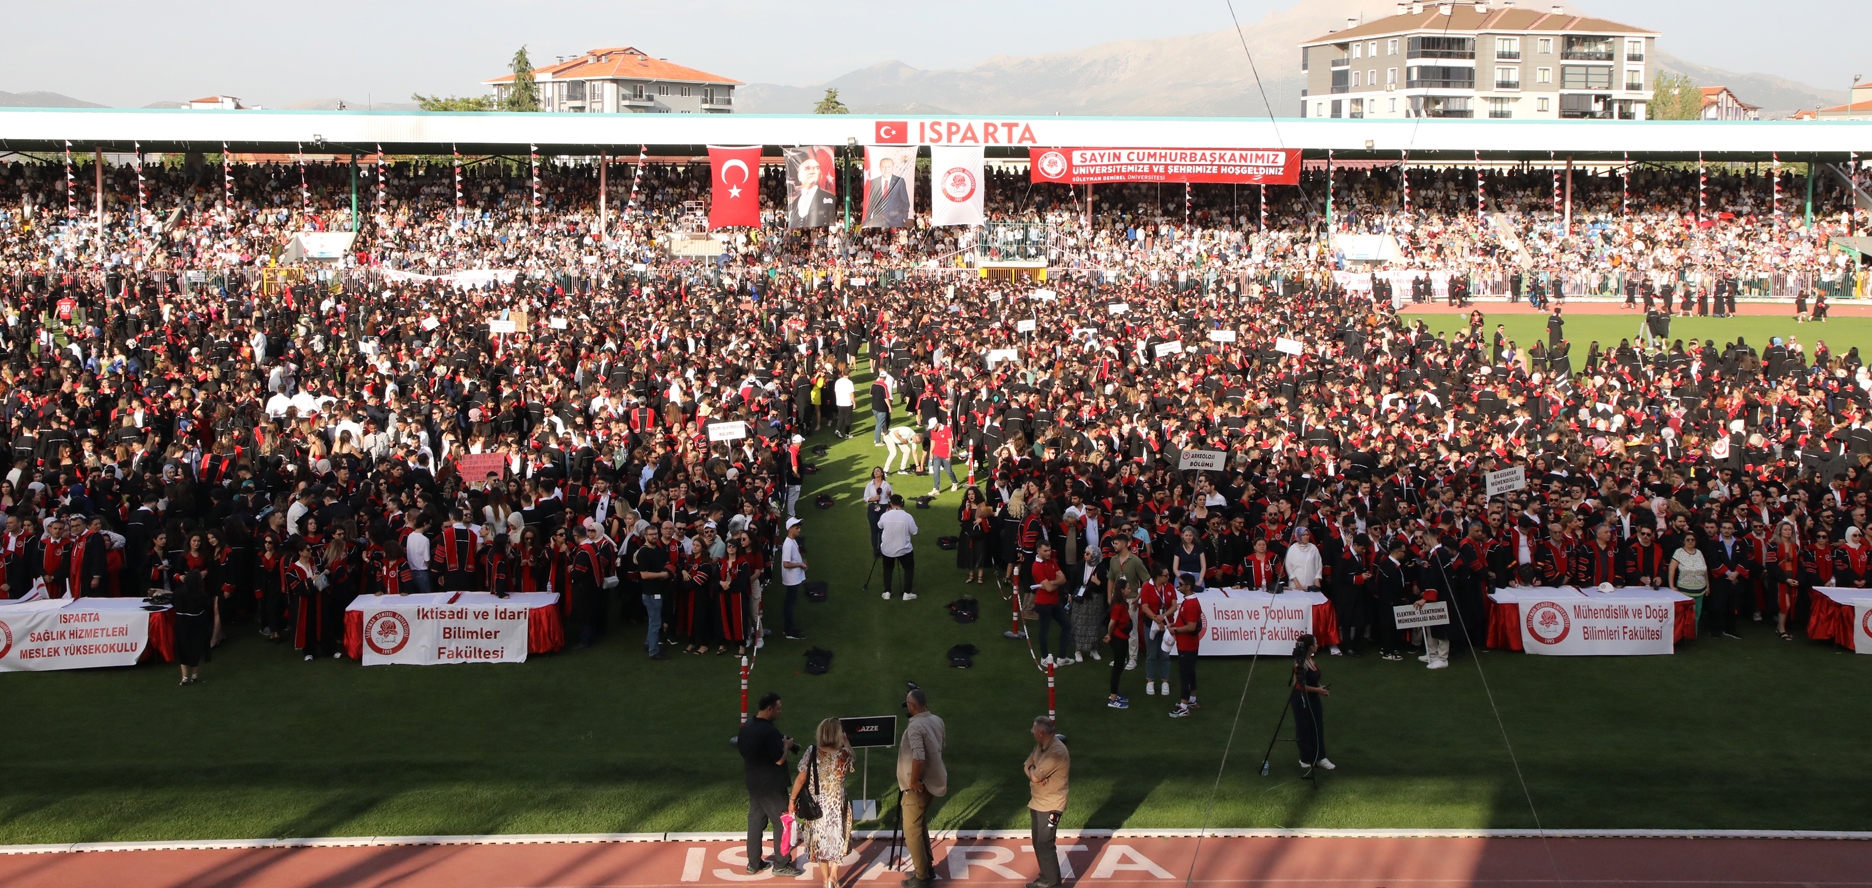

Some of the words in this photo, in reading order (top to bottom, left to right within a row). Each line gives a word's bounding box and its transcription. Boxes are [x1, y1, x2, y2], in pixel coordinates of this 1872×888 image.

[919, 121, 1038, 144] ISPARTA
[1079, 151, 1121, 163] SAYIN
[1127, 151, 1280, 165] CUMHURBAŞKANIMIZ
[1153, 165, 1165, 173] VE
[1167, 165, 1218, 174] ŞEHRİMİZE
[60, 304, 71, 313] 90
[1189, 460, 1214, 468] BÖLÜMÜ
[1497, 483, 1515, 492] BÖLÜMÜ
[59, 612, 100, 624] ISPARTA
[417, 605, 468, 620] İktisadi
[473, 610, 489, 620] ve
[494, 605, 528, 620] İdari
[1213, 603, 1244, 620] İnsan
[1246, 610, 1260, 620] ve
[1262, 606, 1304, 623] Toplum
[1396, 610, 1416, 618] ELEKTRİK
[1573, 605, 1629, 620] Mühendislik
[1631, 609, 1643, 619] ve
[1645, 605, 1669, 623] Doğa
[29, 629, 66, 643] SAĞLIK
[69, 624, 129, 640] HİZMETLERİ
[442, 627, 501, 640] Bilimler
[1211, 627, 1257, 641] Bilimleri
[1260, 627, 1308, 641] Fakültesi
[1582, 626, 1620, 641] Bilimleri
[1622, 626, 1663, 641] Fakültesi
[19, 646, 61, 660] MESLEK
[64, 642, 138, 656] YÜKSEKOKULU
[437, 646, 505, 659] Fakültesi
